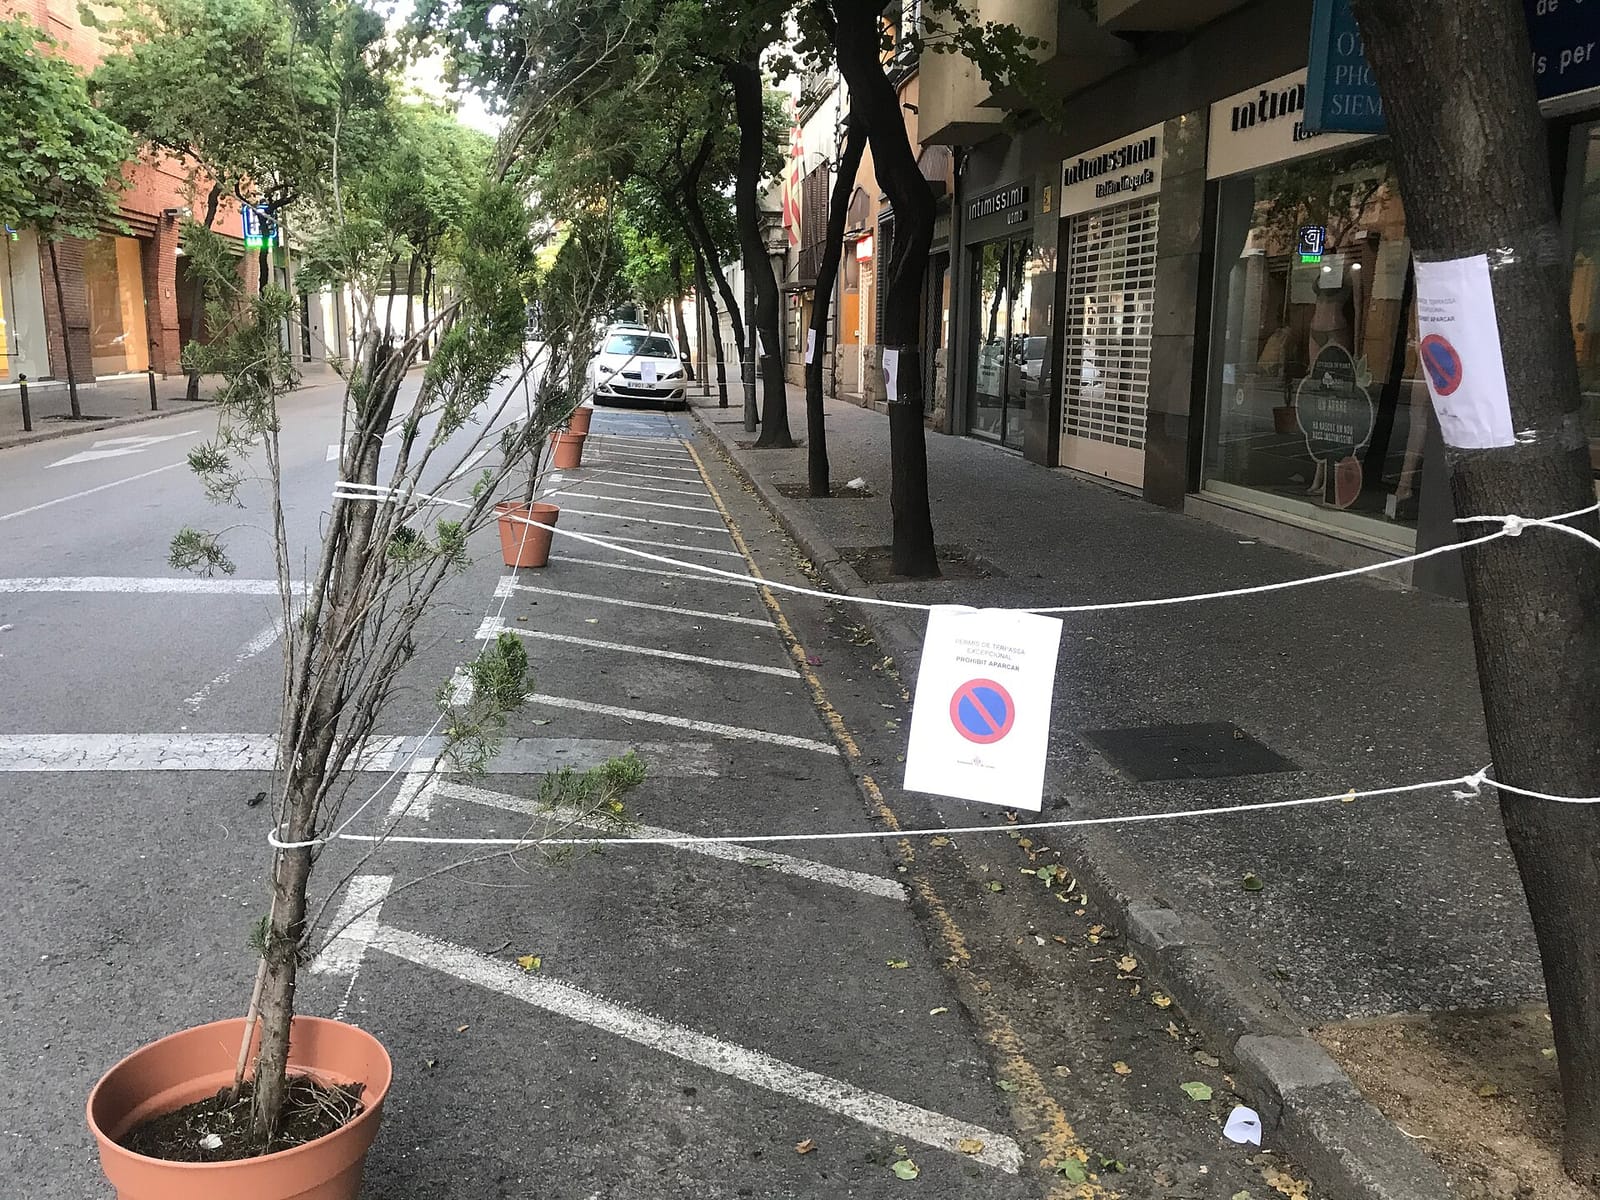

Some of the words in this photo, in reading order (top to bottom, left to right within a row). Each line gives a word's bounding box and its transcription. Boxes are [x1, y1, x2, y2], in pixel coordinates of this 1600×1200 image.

[1336, 31, 1365, 56] OT
[1560, 41, 1596, 74] per
[1335, 64, 1377, 87] PHO
[1231, 83, 1305, 132] intim
[1331, 93, 1384, 116] SIEM
[1064, 136, 1156, 186] intimissimi
[968, 186, 1024, 220] intimissimi
[955, 655, 987, 666] PROHIBIT
[988, 660, 1020, 673] APARCAR
